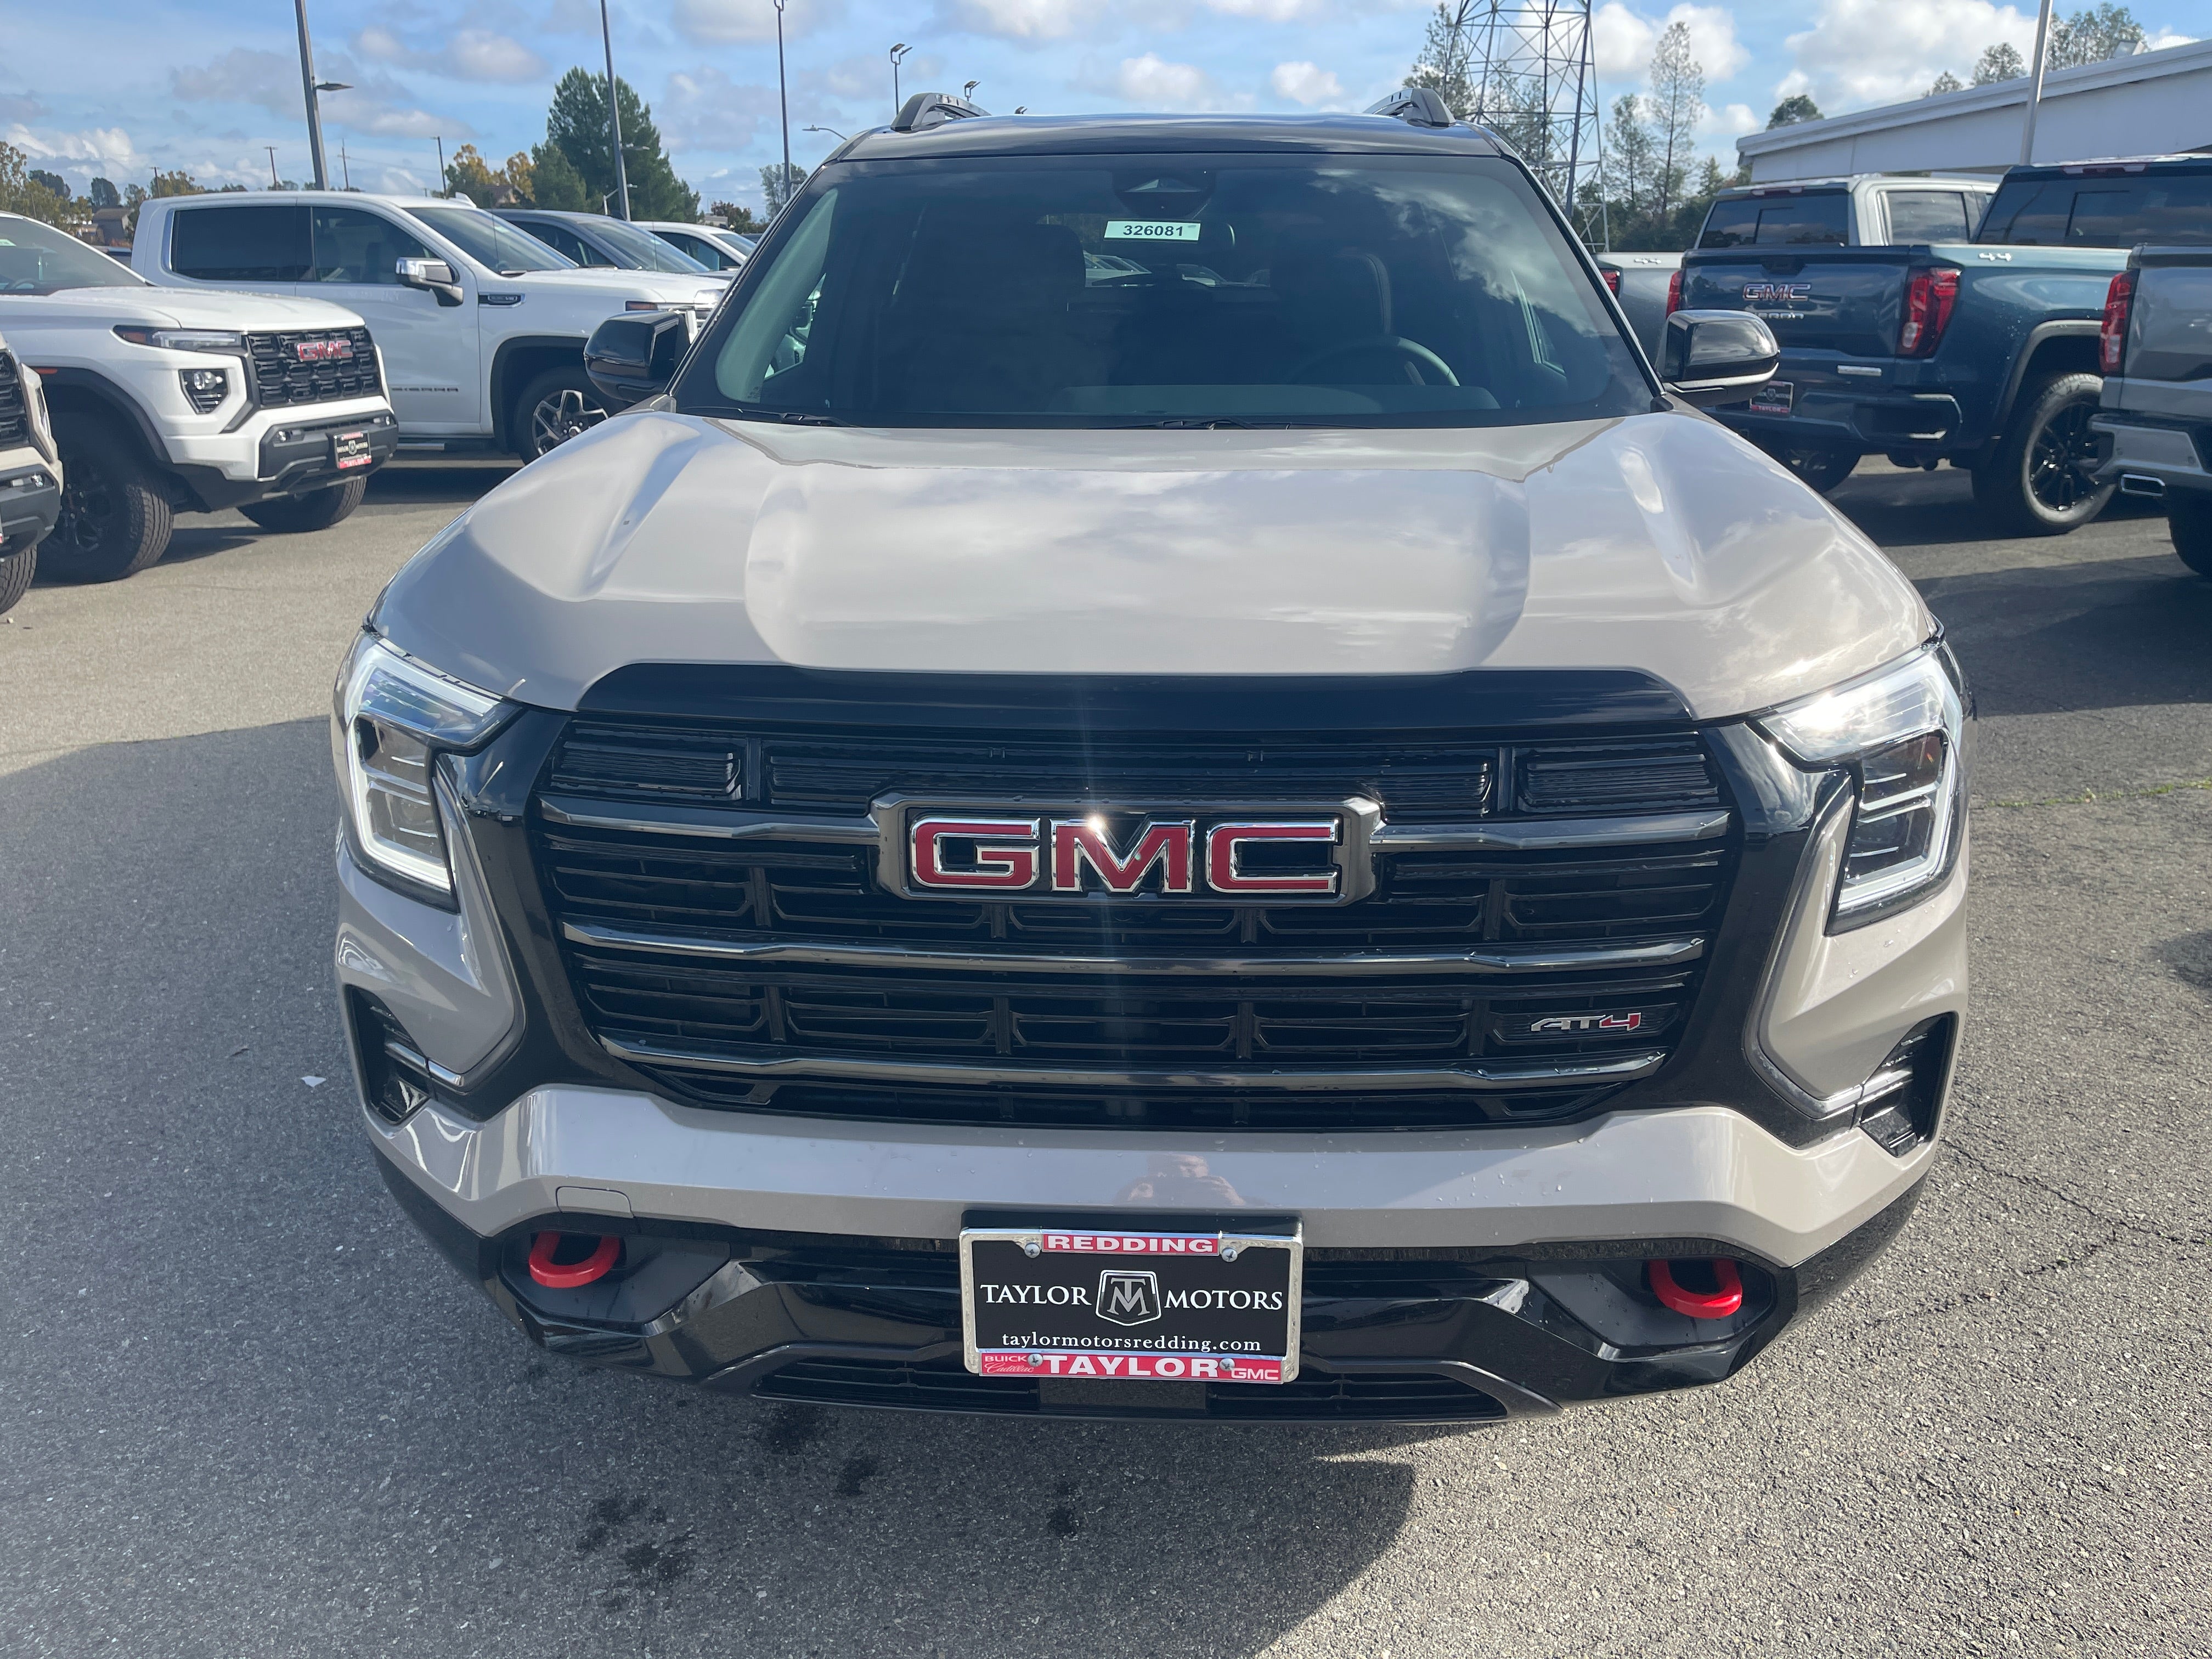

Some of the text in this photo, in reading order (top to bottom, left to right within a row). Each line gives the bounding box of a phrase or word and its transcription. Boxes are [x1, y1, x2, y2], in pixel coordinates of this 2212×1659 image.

[1123, 225, 1183, 236] 326081
[1743, 283, 1811, 301] GMC
[297, 340, 353, 362] GMC
[910, 816, 1340, 894] GMC
[1531, 1012, 1641, 1031] AT4
[1047, 1235, 1214, 1254] REDDING
[980, 1284, 1092, 1307] TAYLOR
[1164, 1290, 1283, 1311] MOTORS
[1002, 1332, 1261, 1353] taylormotorsredding.com
[984, 1362, 1034, 1374] Cadillac
[1043, 1355, 1218, 1378] TAYLOR
[1231, 1368, 1279, 1380] GMC
